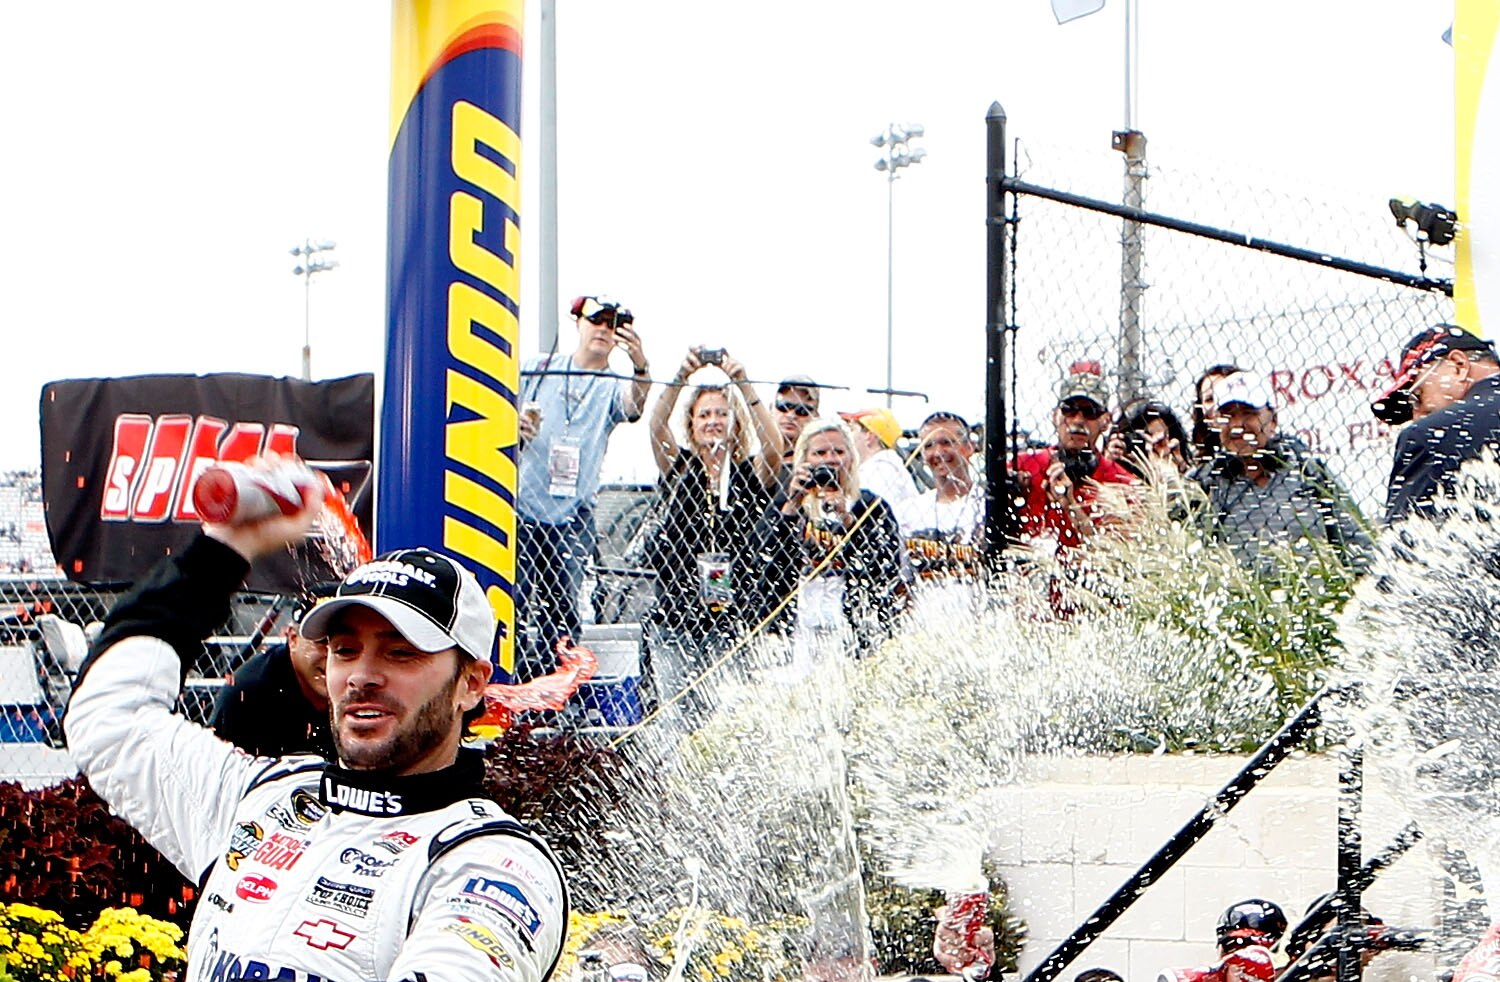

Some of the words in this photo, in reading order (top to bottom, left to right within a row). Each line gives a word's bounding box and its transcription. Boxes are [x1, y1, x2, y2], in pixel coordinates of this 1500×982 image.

[443, 100, 522, 677] SUNOCO
[325, 778, 403, 815] LOWE'S
[473, 877, 538, 926] LOWE'S
